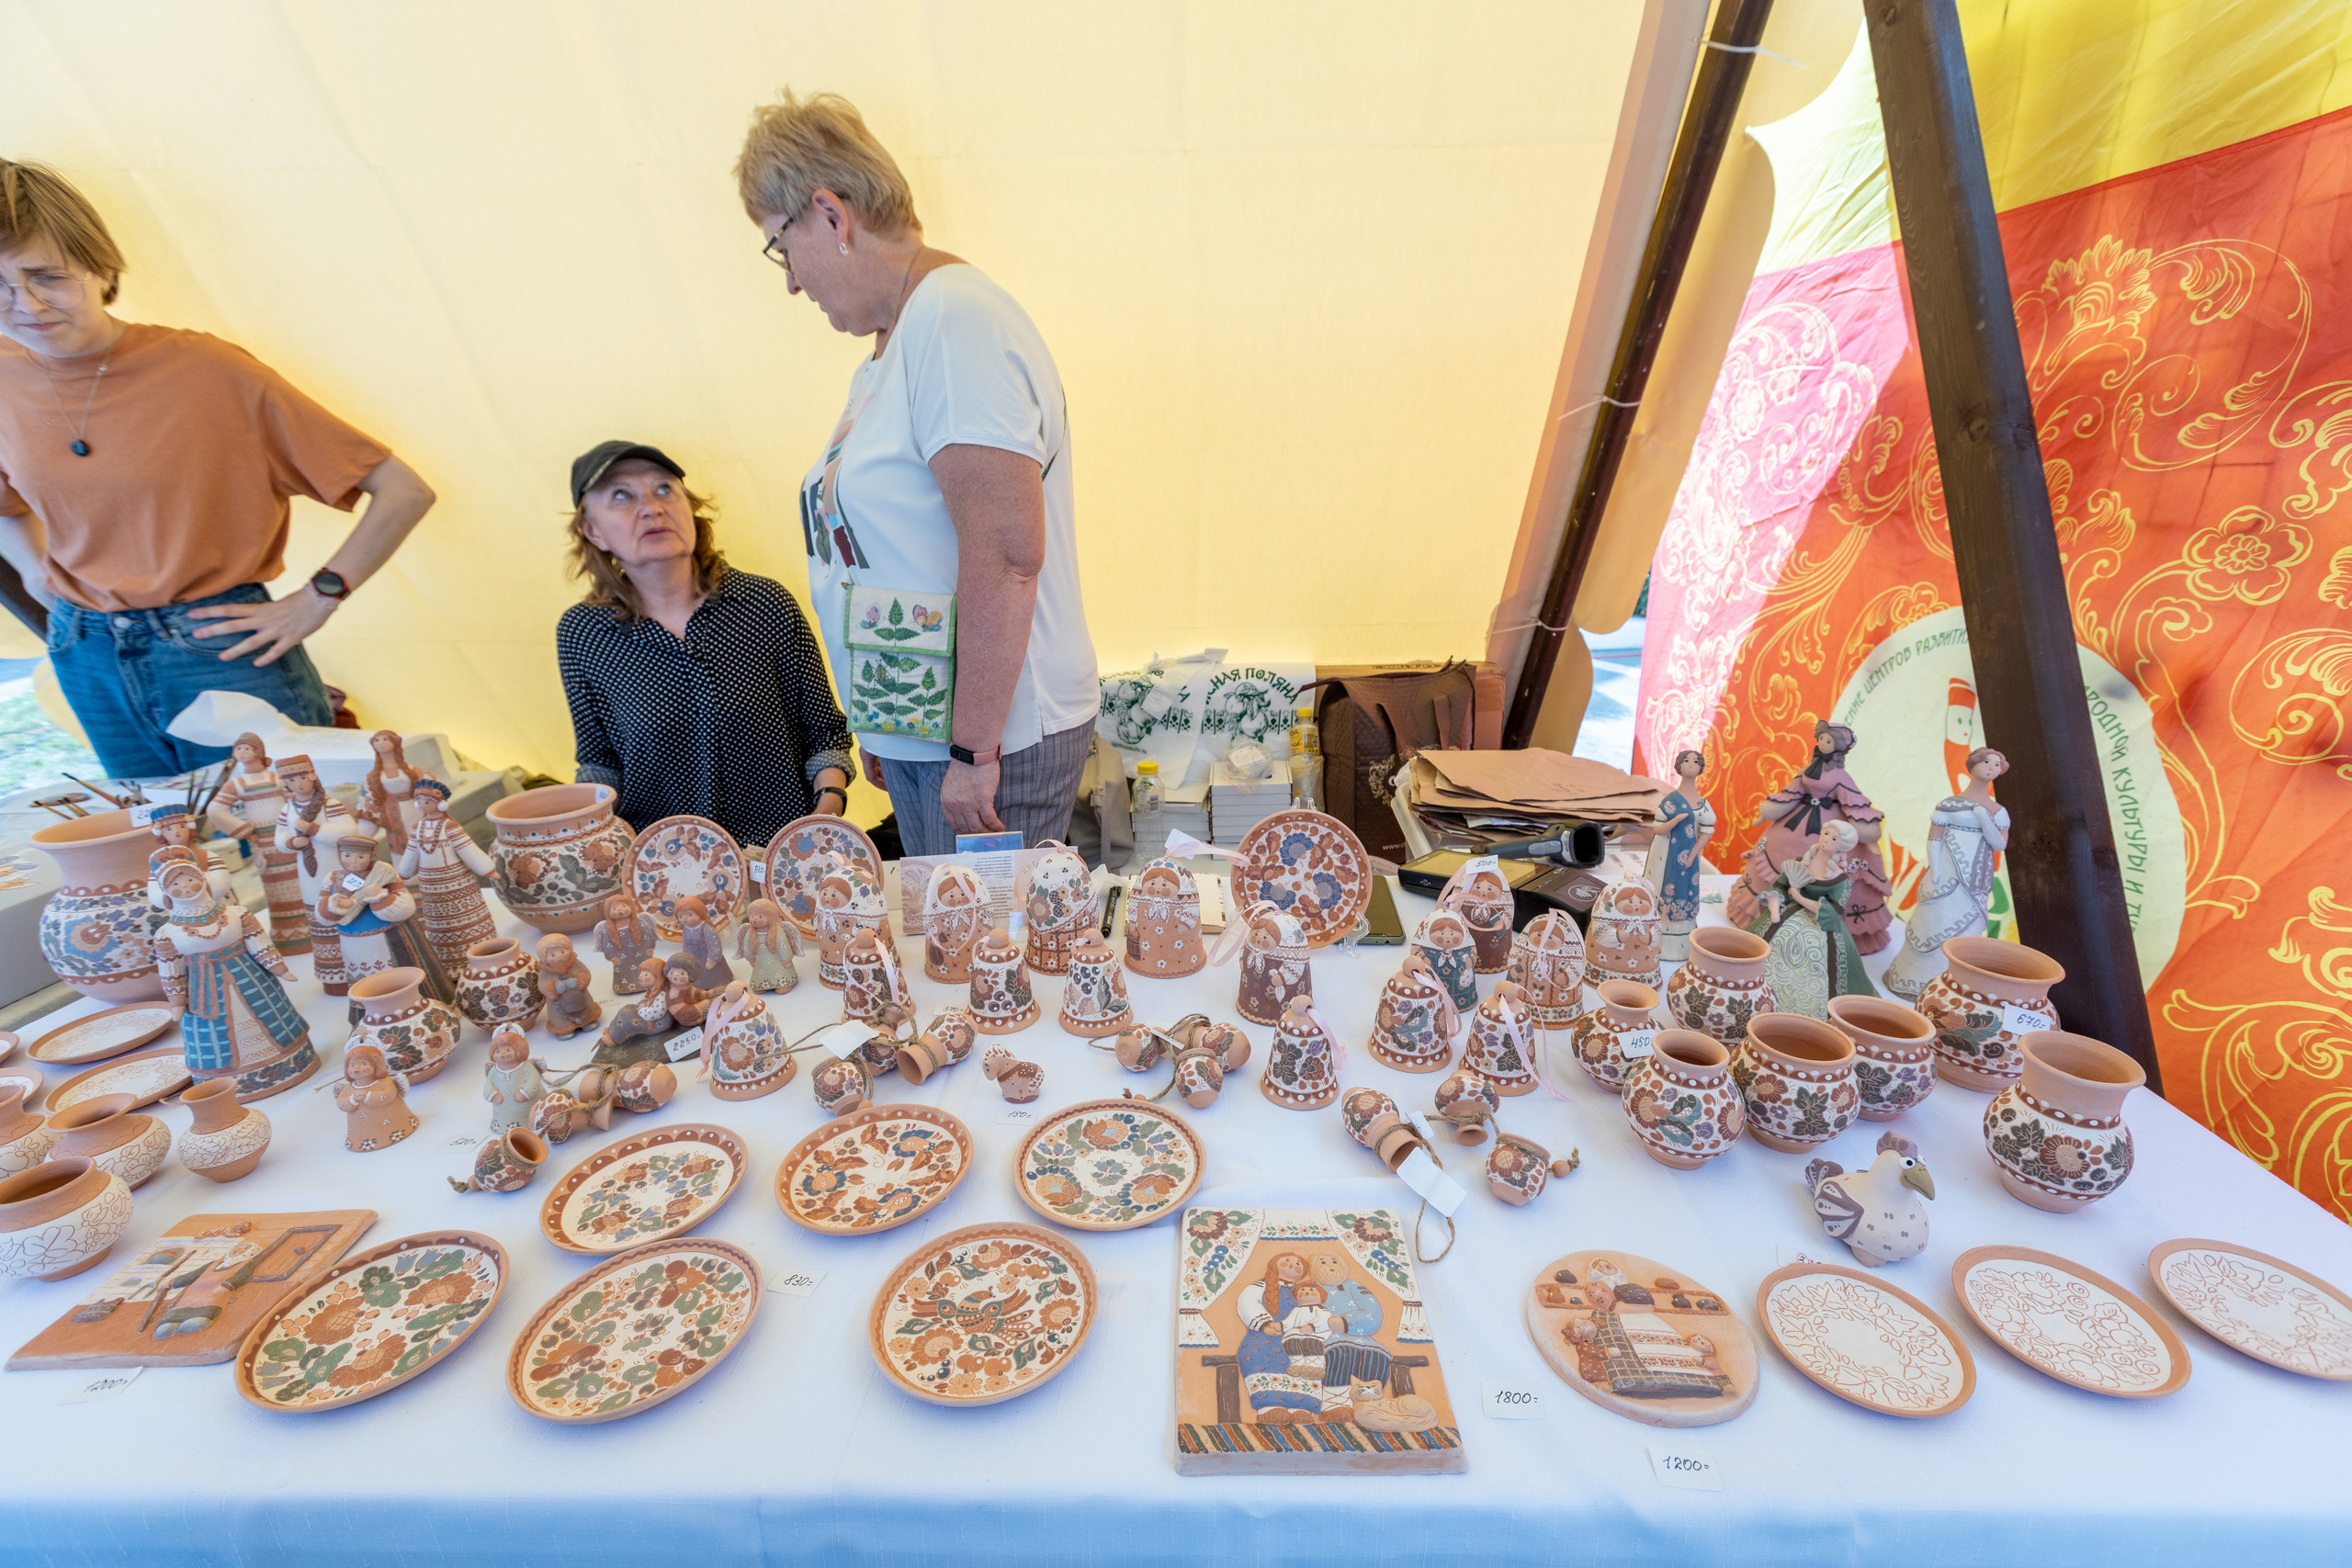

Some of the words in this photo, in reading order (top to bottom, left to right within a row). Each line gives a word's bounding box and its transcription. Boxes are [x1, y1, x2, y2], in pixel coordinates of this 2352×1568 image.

[1206, 669, 1241, 705] СНАЯ
[1246, 668, 1298, 705] ПОЛЯНА
[1864, 647, 1912, 694] ЦЕНТРОВ
[1843, 691, 1866, 728] ЕНИЕ
[2086, 685, 2129, 762] РОДНОЙ
[2111, 767, 2148, 873] КУЛЬТУРЫ
[2124, 879, 2144, 895] И
[1631, 1036, 1653, 1049] 450
[1495, 1390, 1538, 1404] 1800=
[1662, 1455, 1710, 1471] 1200=
